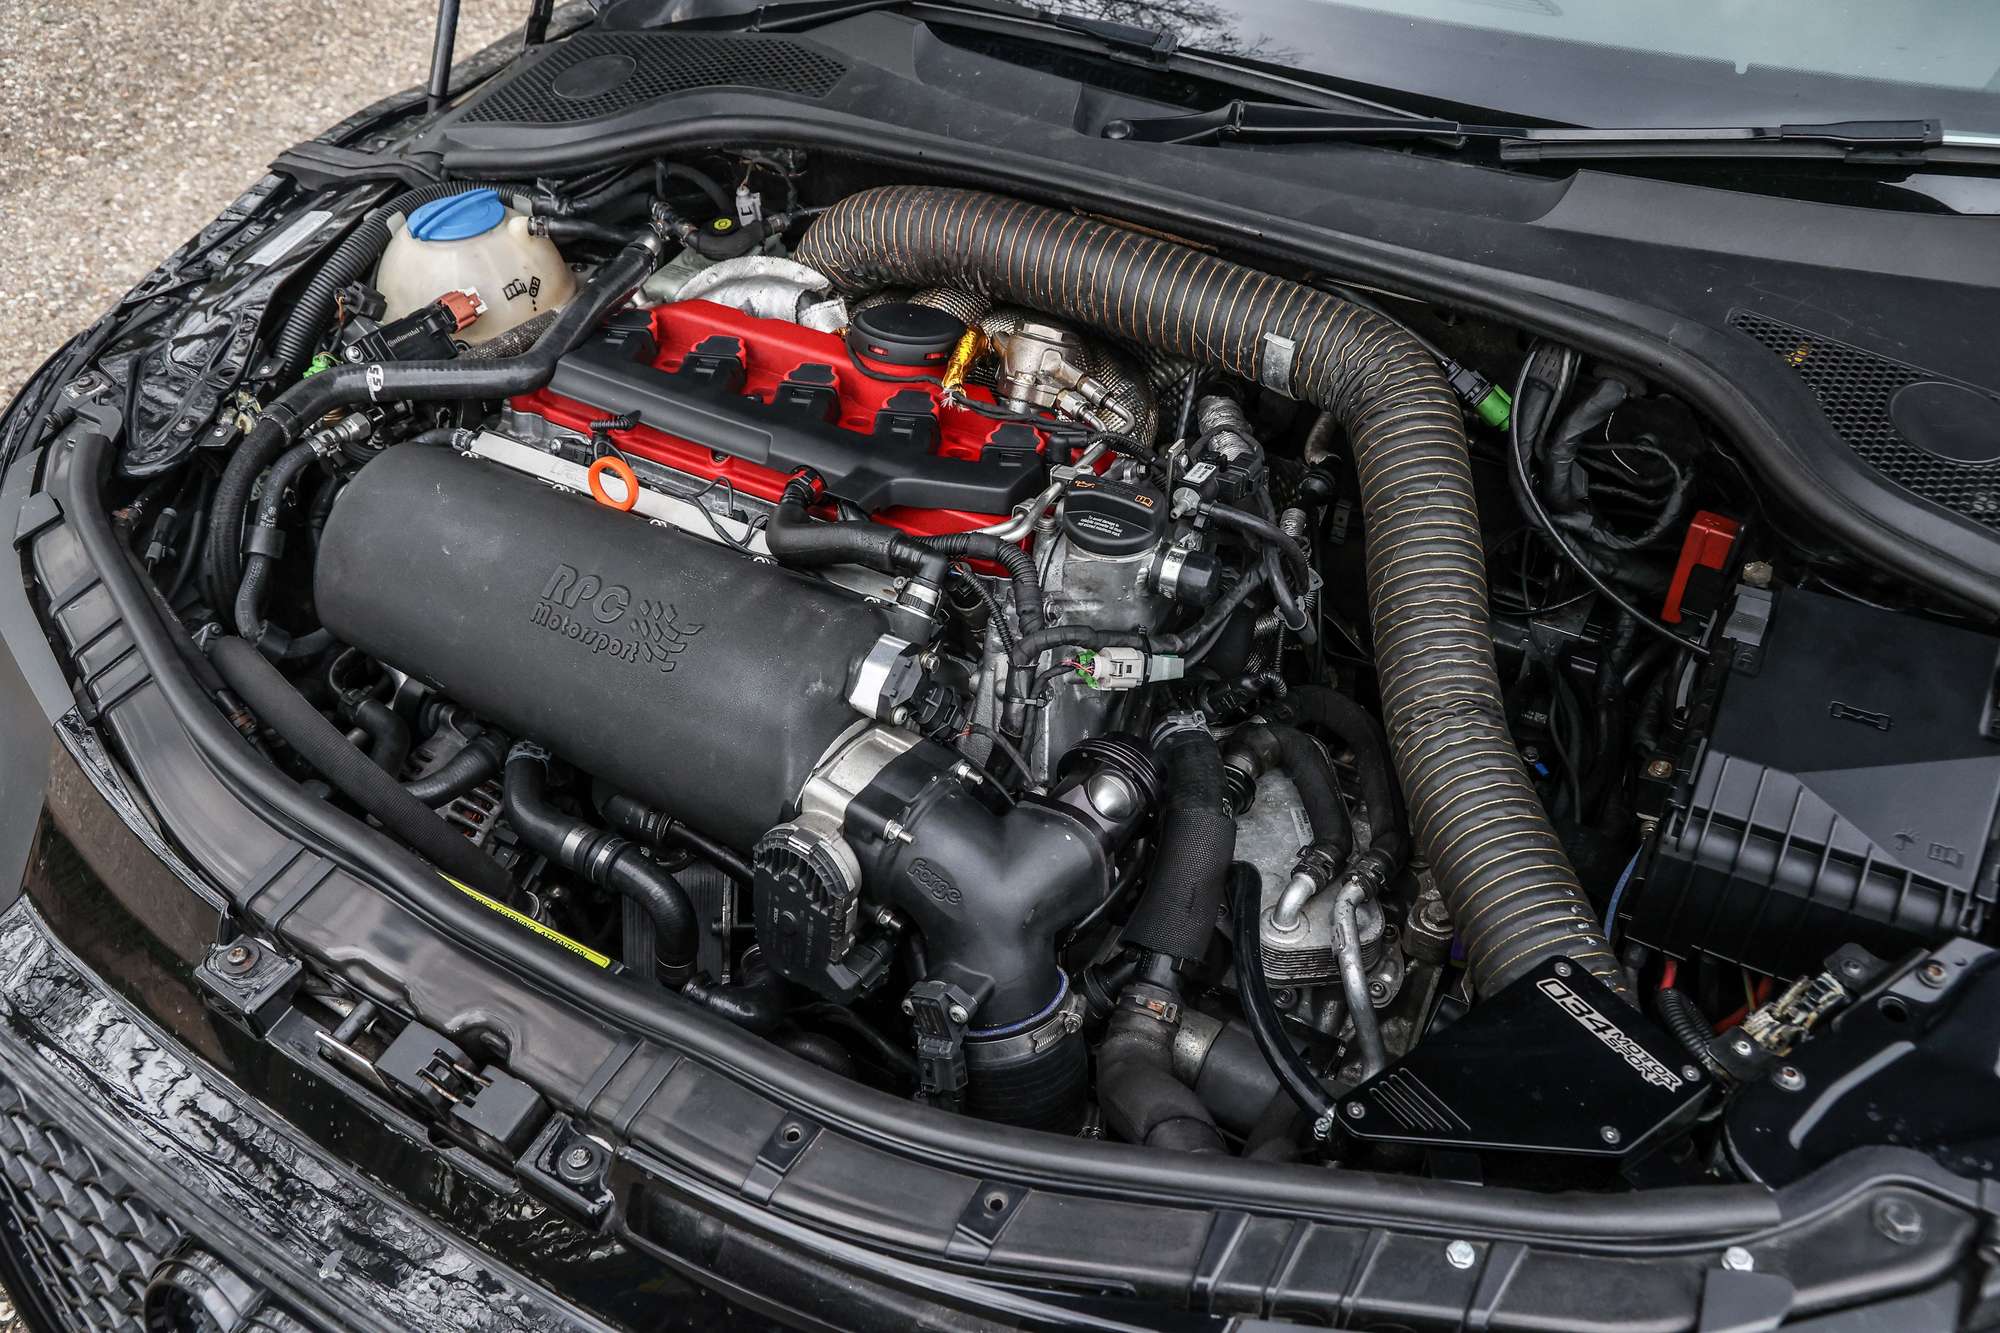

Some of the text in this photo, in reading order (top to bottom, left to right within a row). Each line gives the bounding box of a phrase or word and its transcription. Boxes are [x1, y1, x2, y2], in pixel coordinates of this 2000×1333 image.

[542, 563, 631, 623] RPC
[1540, 980, 1680, 1087] 034 MOTOR
[1603, 1037, 1670, 1085] SPORT
